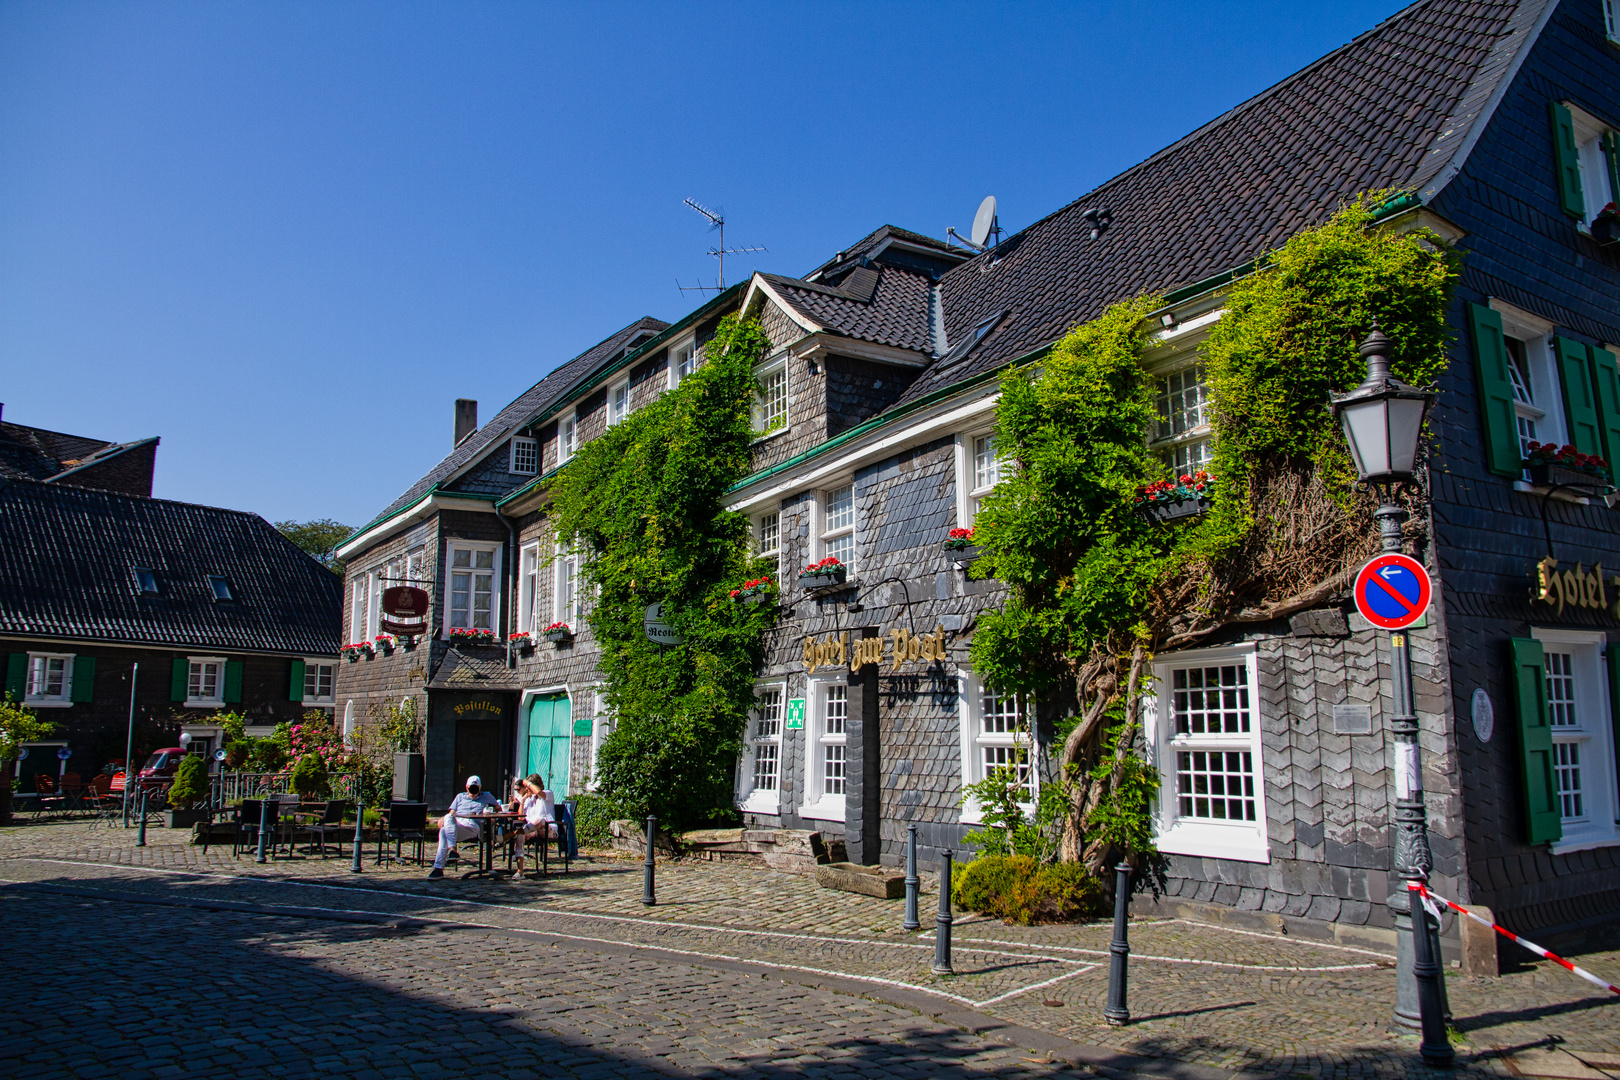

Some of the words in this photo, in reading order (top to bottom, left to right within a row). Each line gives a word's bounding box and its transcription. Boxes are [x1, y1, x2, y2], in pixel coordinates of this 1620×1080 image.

[1537, 555, 1608, 617] Hotel
[802, 631, 848, 674] Hotel
[850, 637, 885, 672] zur
[890, 624, 947, 670] Post
